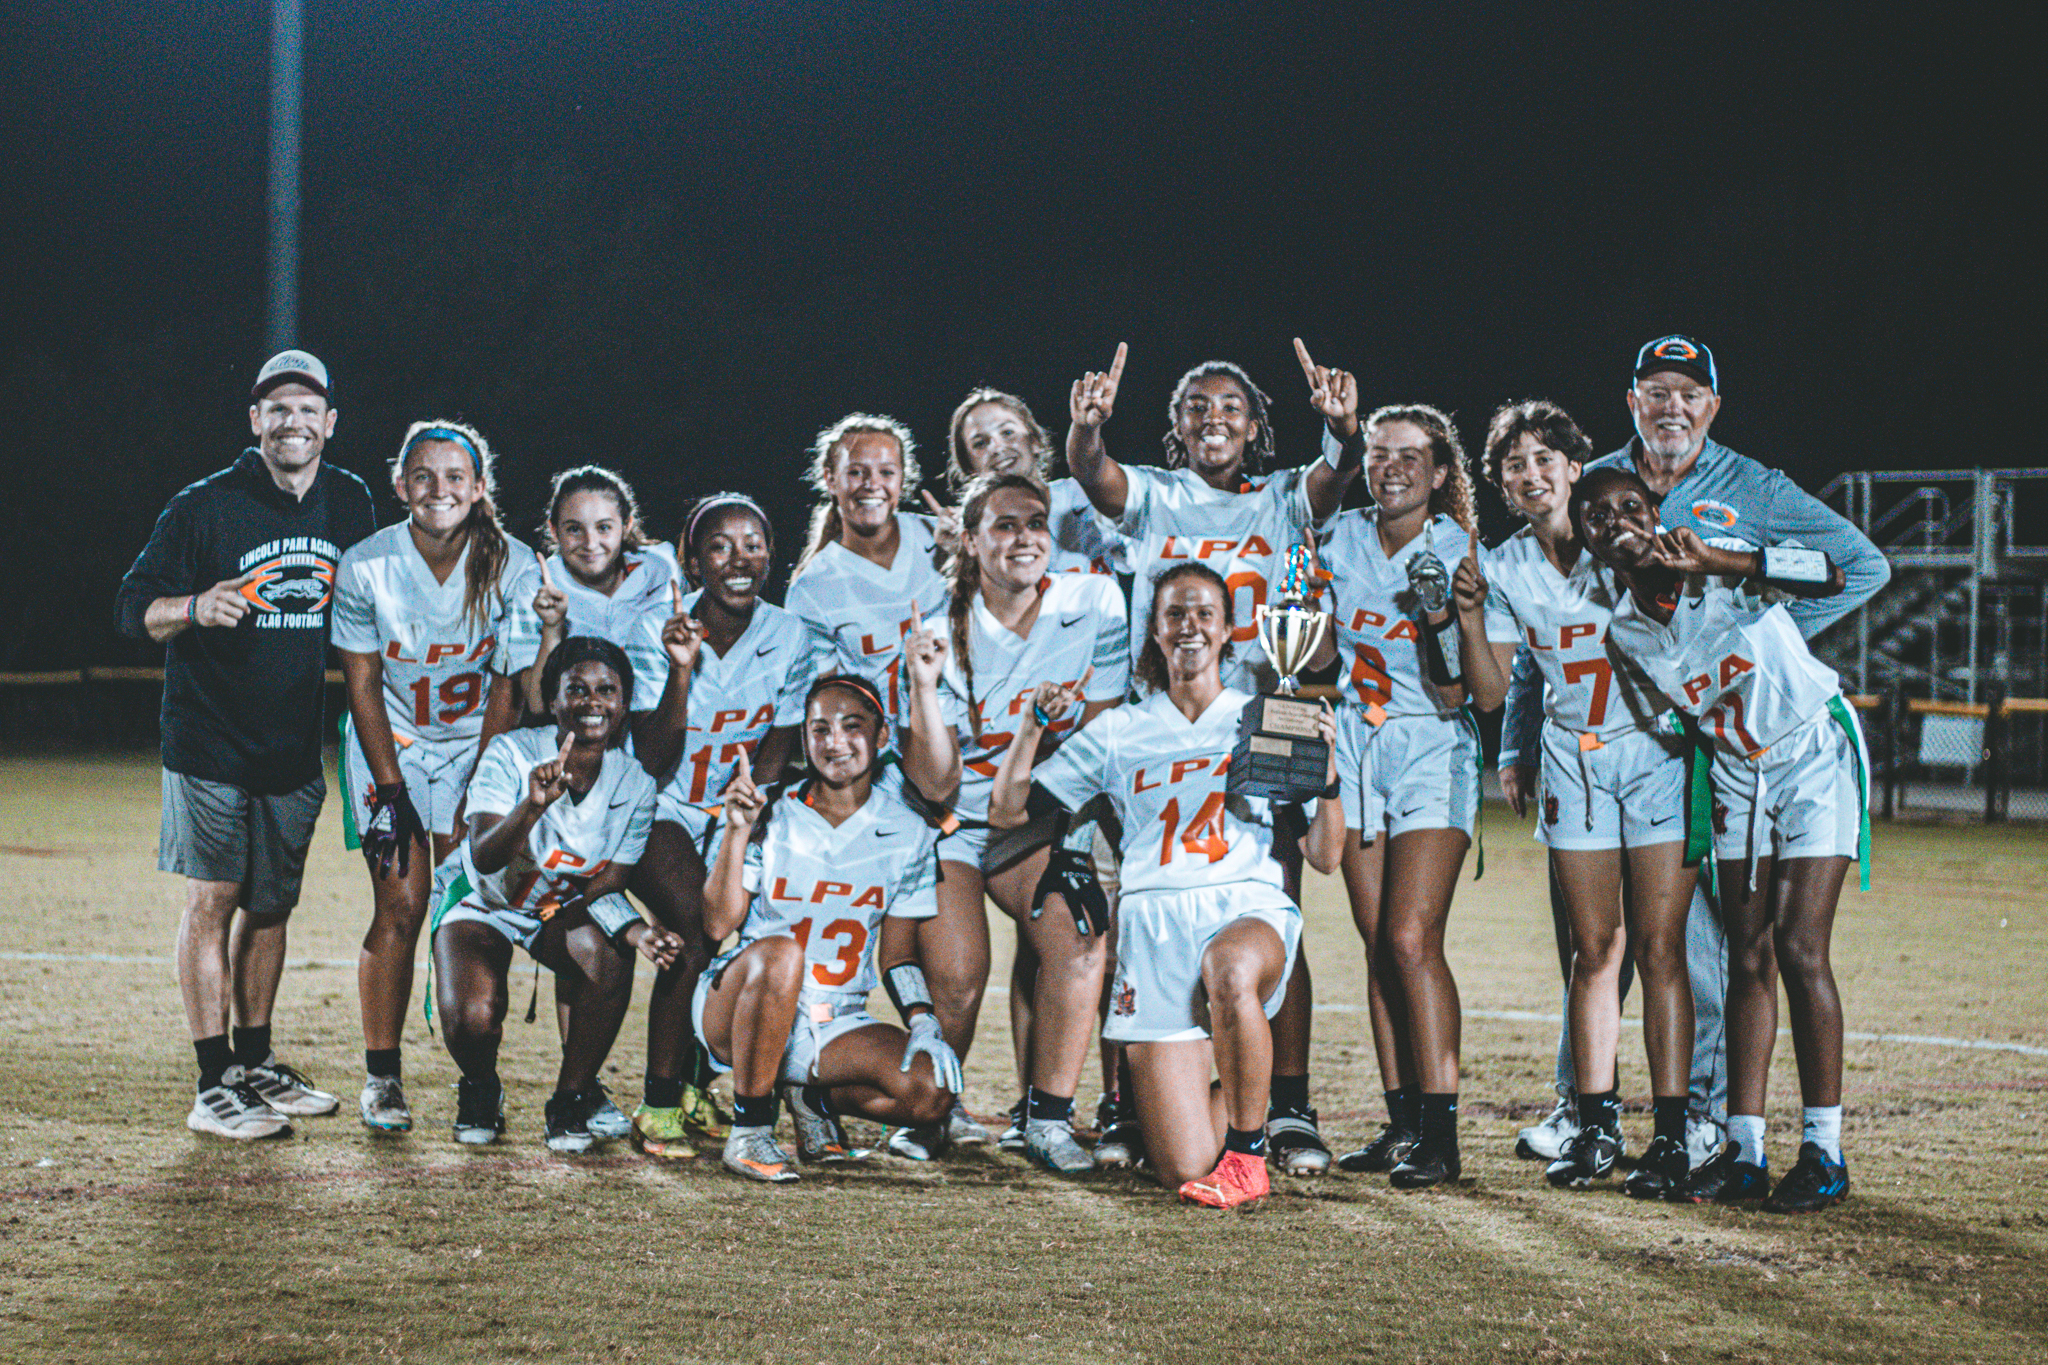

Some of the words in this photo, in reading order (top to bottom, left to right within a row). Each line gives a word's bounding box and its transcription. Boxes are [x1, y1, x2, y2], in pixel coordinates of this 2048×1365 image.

[240, 538, 281, 571] LINCOLN
[282, 536, 309, 554] PARK
[1160, 535, 1273, 559] LPA
[256, 613, 281, 628] FLAG
[1333, 608, 1418, 644] PA
[1526, 623, 1606, 651] LP
[386, 634, 495, 664] LPA
[409, 671, 482, 724] 19
[1562, 657, 1613, 727] 7
[1666, 653, 1755, 709] PA
[686, 703, 775, 733] PA
[1158, 791, 1229, 866] 14
[772, 877, 884, 909] LPA
